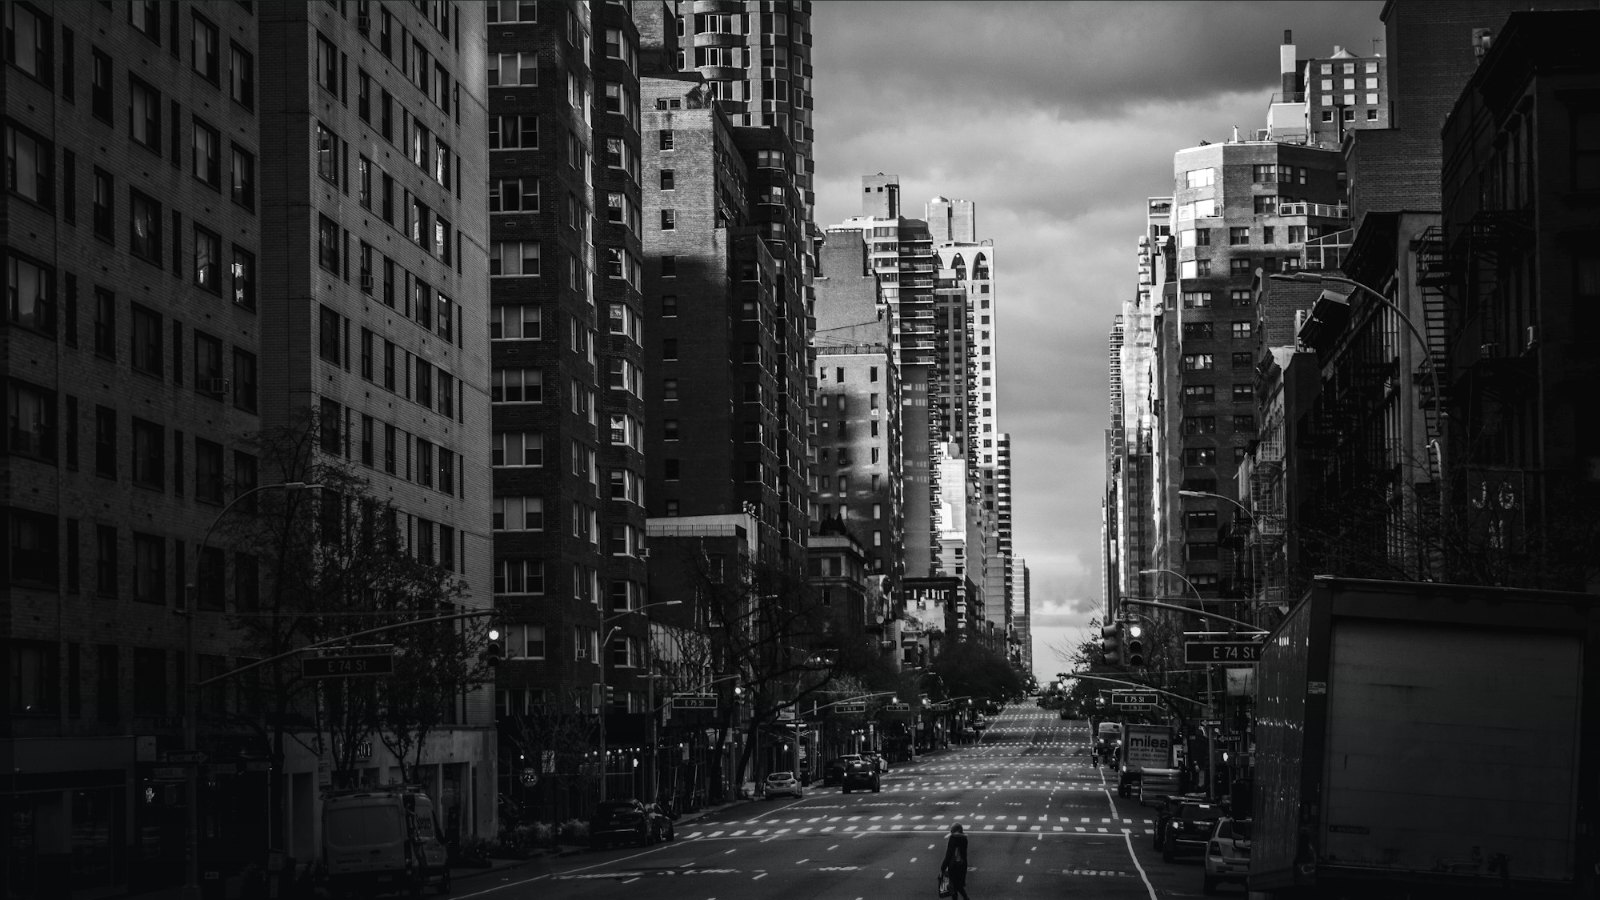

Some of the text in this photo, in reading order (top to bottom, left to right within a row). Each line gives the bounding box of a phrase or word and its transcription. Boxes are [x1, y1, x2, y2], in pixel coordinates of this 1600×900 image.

[1213, 646, 1255, 659] E 74 St
[327, 658, 367, 673] E 74 St
[1130, 735, 1168, 748] milea
